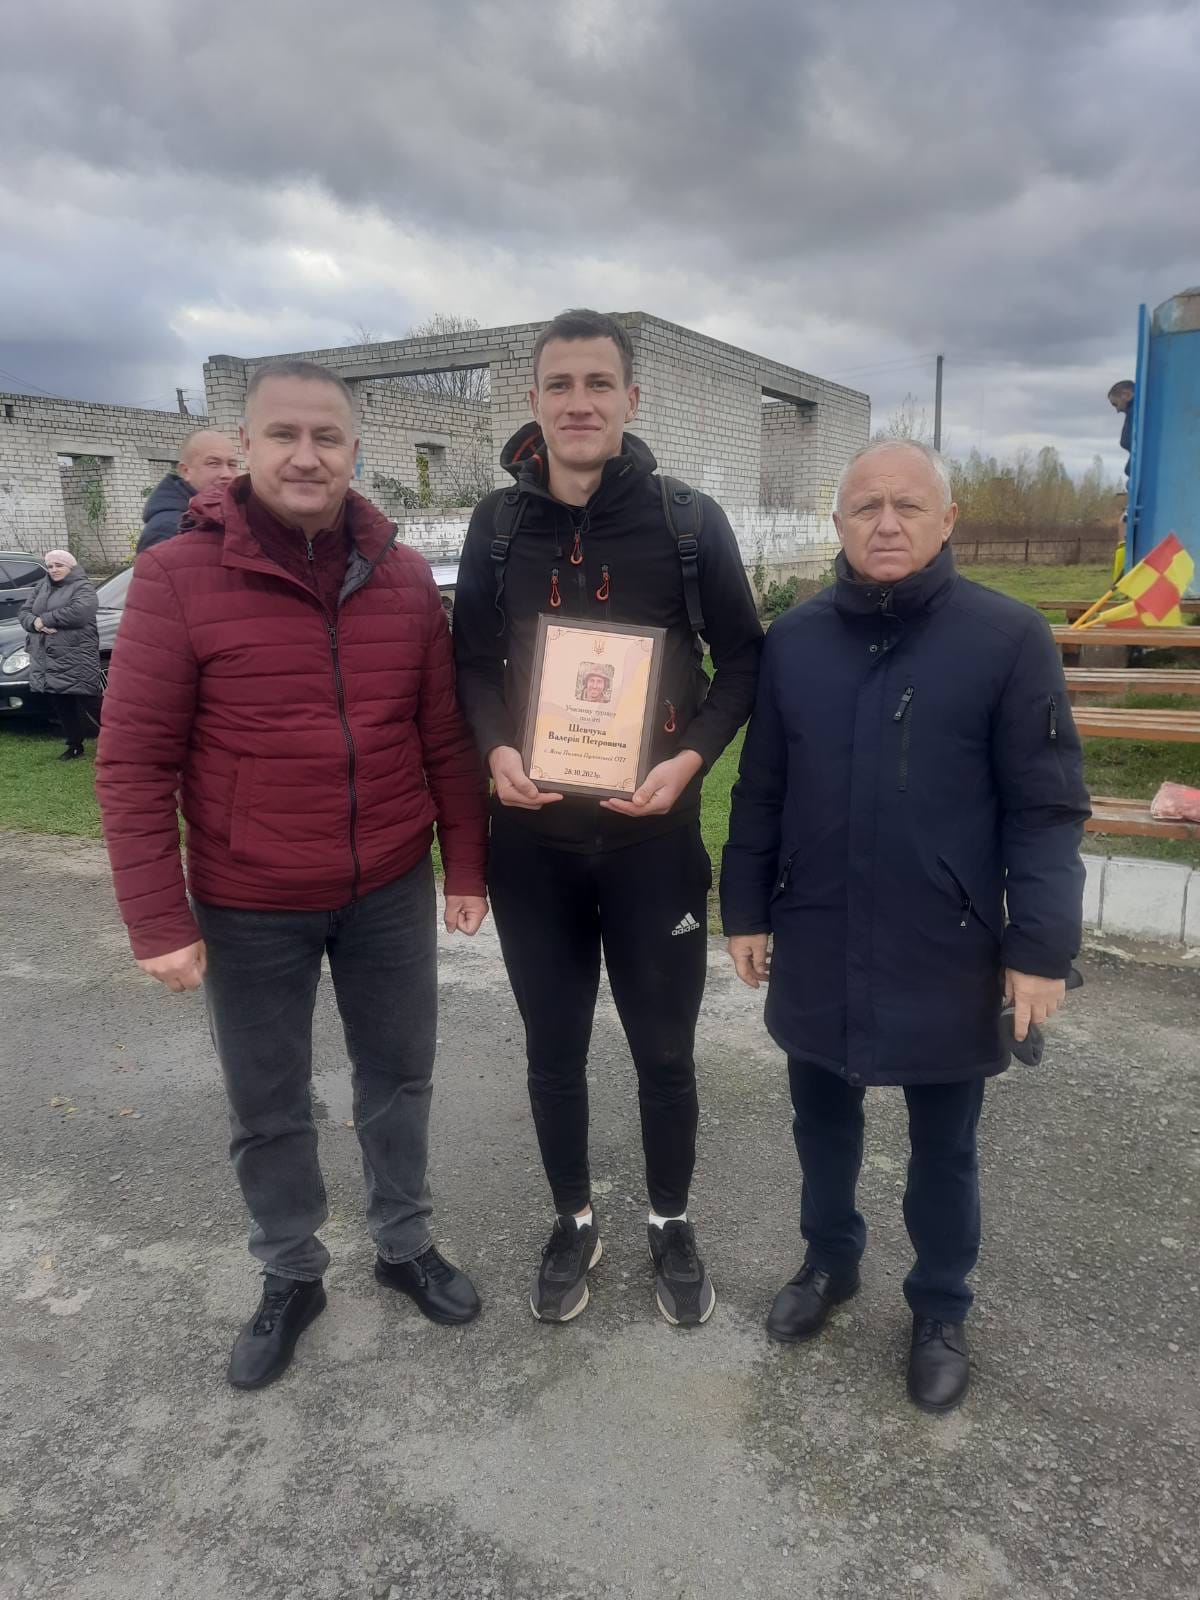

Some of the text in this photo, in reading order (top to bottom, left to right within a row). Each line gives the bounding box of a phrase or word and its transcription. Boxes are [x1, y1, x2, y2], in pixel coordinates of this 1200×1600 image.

[568, 723, 607, 736] Шевчука
[548, 731, 627, 748] Валерія Петровича
[671, 922, 700, 936] adidas
